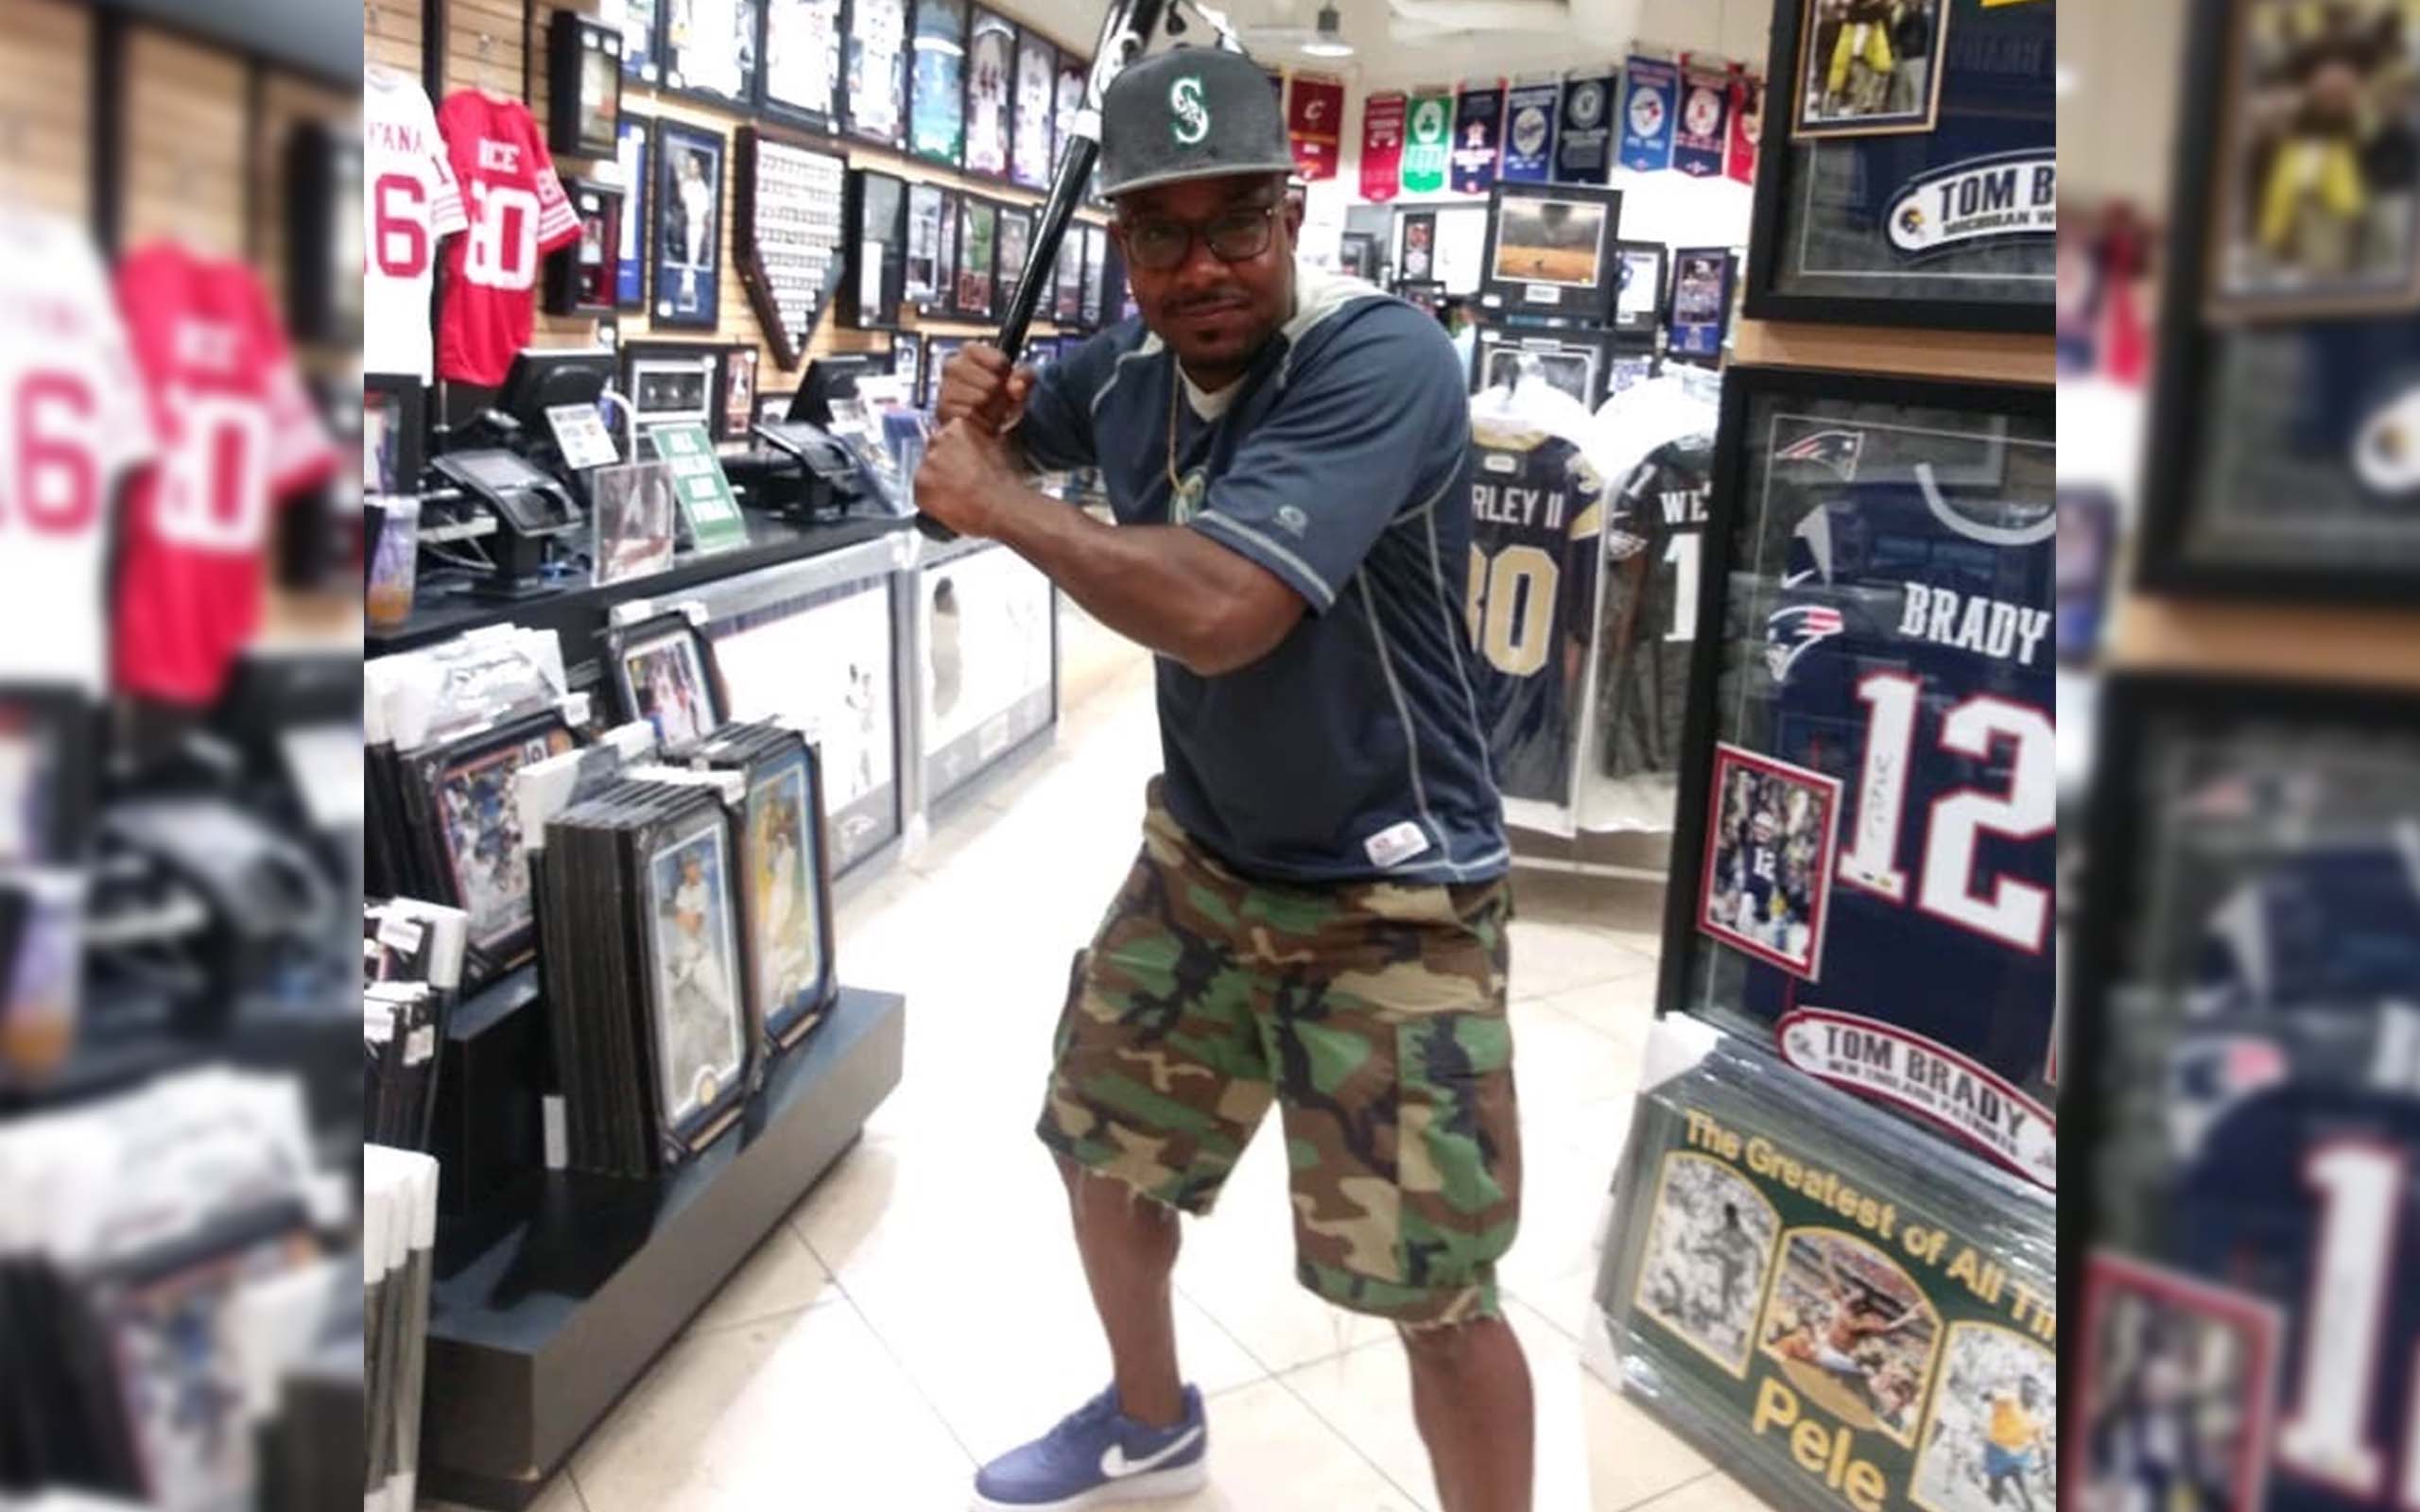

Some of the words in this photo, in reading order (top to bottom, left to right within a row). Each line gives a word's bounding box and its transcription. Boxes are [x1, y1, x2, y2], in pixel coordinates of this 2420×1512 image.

[1170, 75, 1209, 144] S
[1940, 167, 2018, 222] TOM
[1544, 490, 1565, 530] II
[1897, 581, 2051, 665] BRADY
[1837, 669, 2056, 954] 12
[1824, 1024, 1893, 1073] TOM
[1906, 1047, 2027, 1140] BRADY
[1684, 1107, 1740, 1162] The
[1745, 1135, 1898, 1240] Greatest
[1902, 1225, 1948, 1267] of
[1945, 1245, 2008, 1305] All
[1753, 1375, 1888, 1512] Pele
